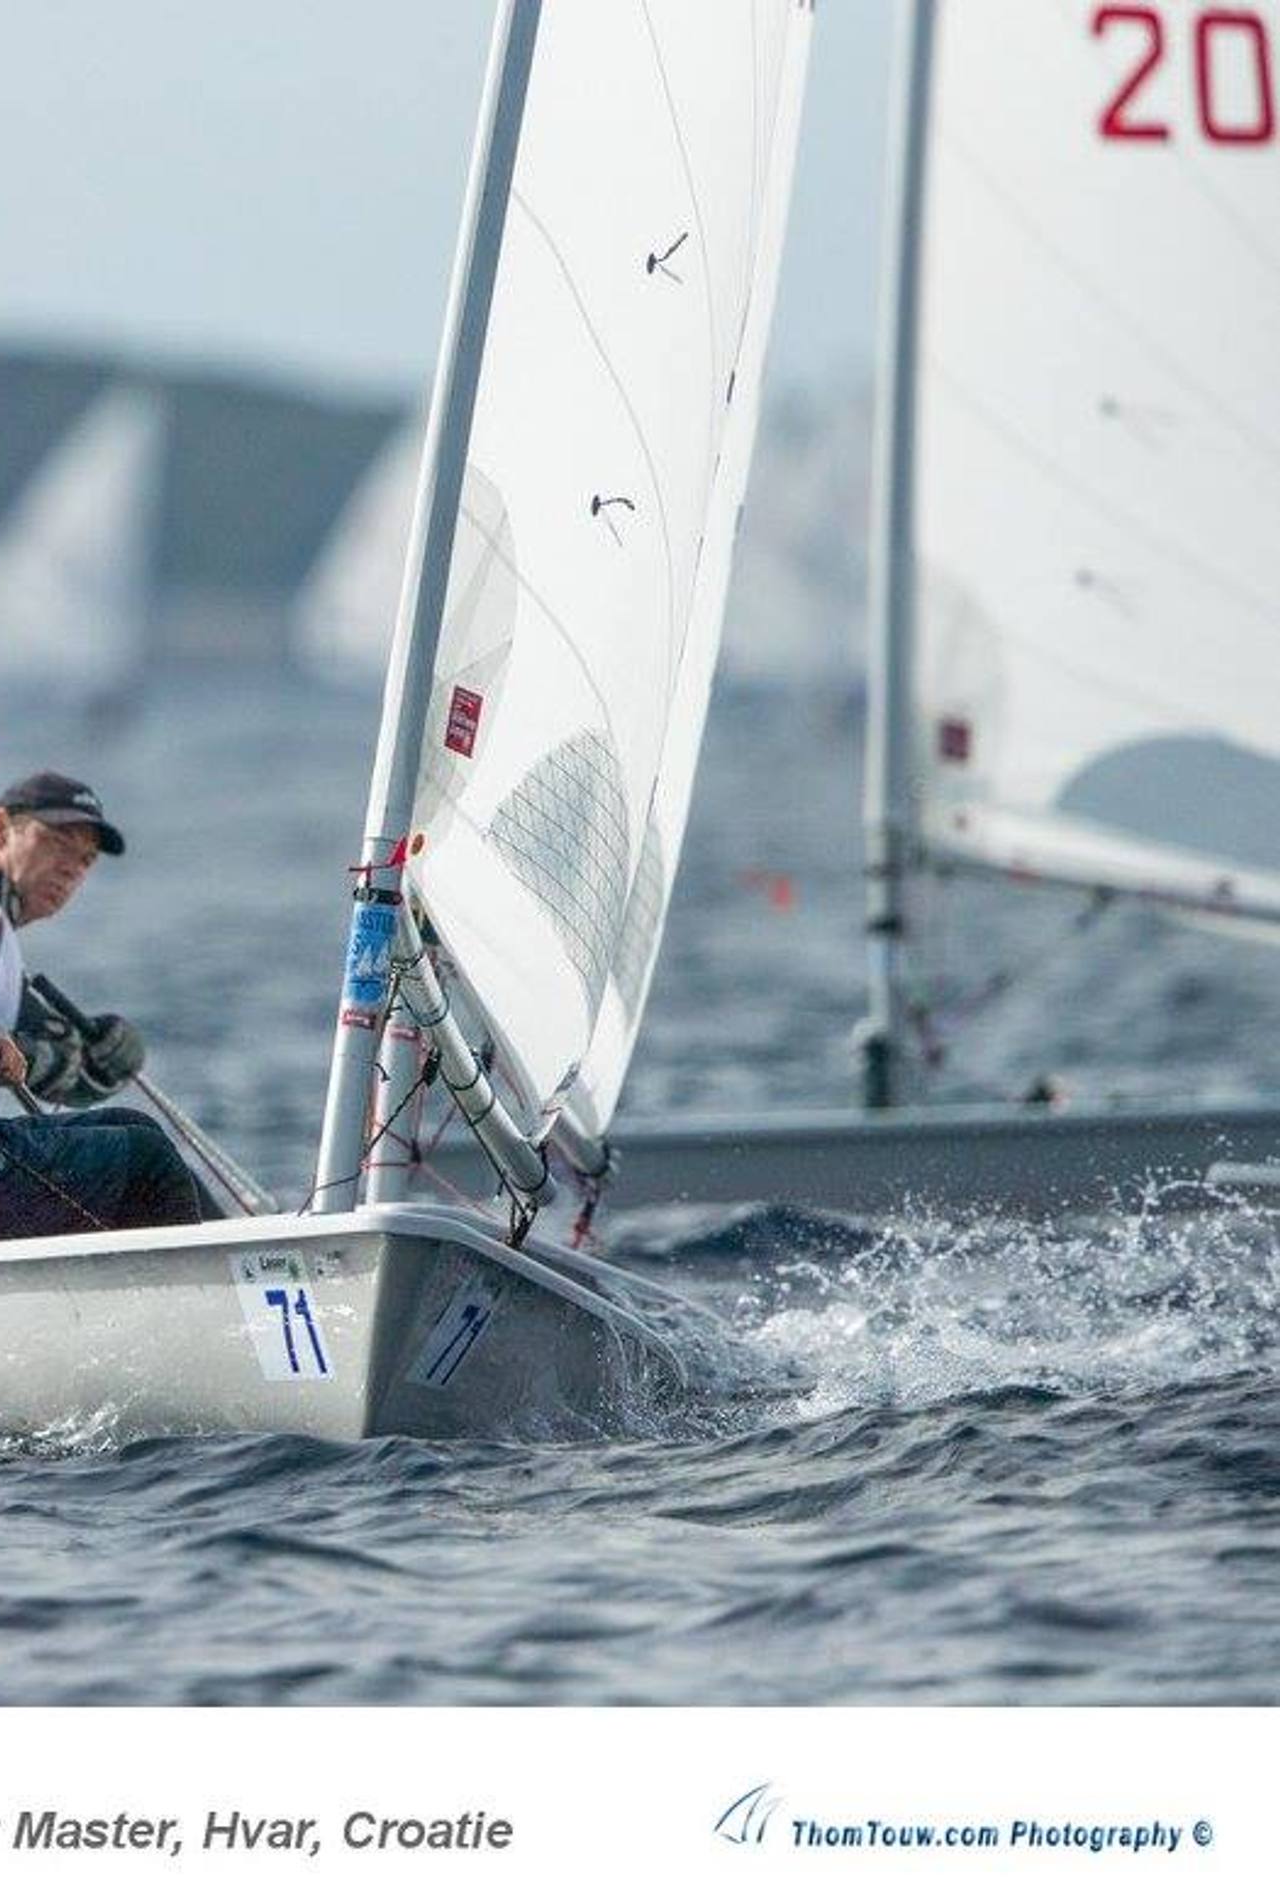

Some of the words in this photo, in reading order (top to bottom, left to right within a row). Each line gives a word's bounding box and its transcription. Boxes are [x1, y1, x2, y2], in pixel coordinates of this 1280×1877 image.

[1091, 8, 1275, 148] 20
[265, 1287, 328, 1374] 71
[425, 1303, 491, 1386] 71
